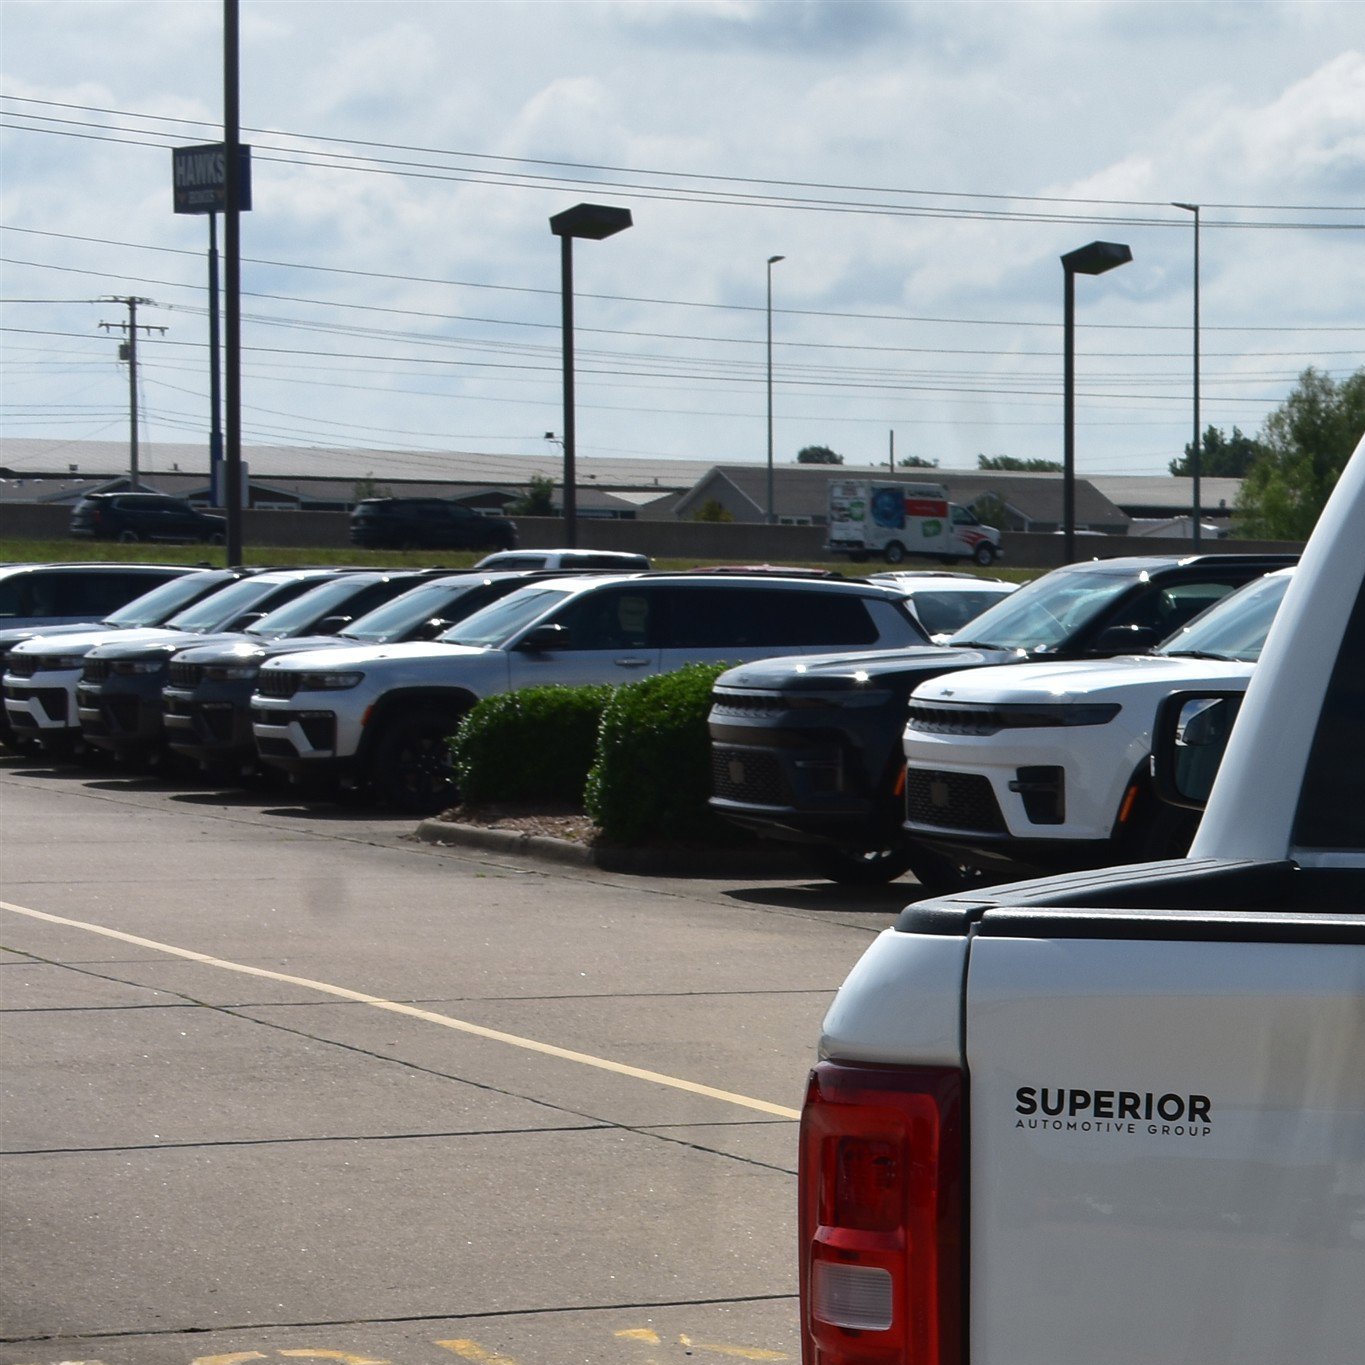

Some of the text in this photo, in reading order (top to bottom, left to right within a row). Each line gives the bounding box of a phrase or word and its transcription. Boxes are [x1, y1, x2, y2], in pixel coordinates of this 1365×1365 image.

[1015, 1086, 1212, 1124] SUPERIOR
[1015, 1119, 1212, 1137] AUTOMOTIVE GROUP
